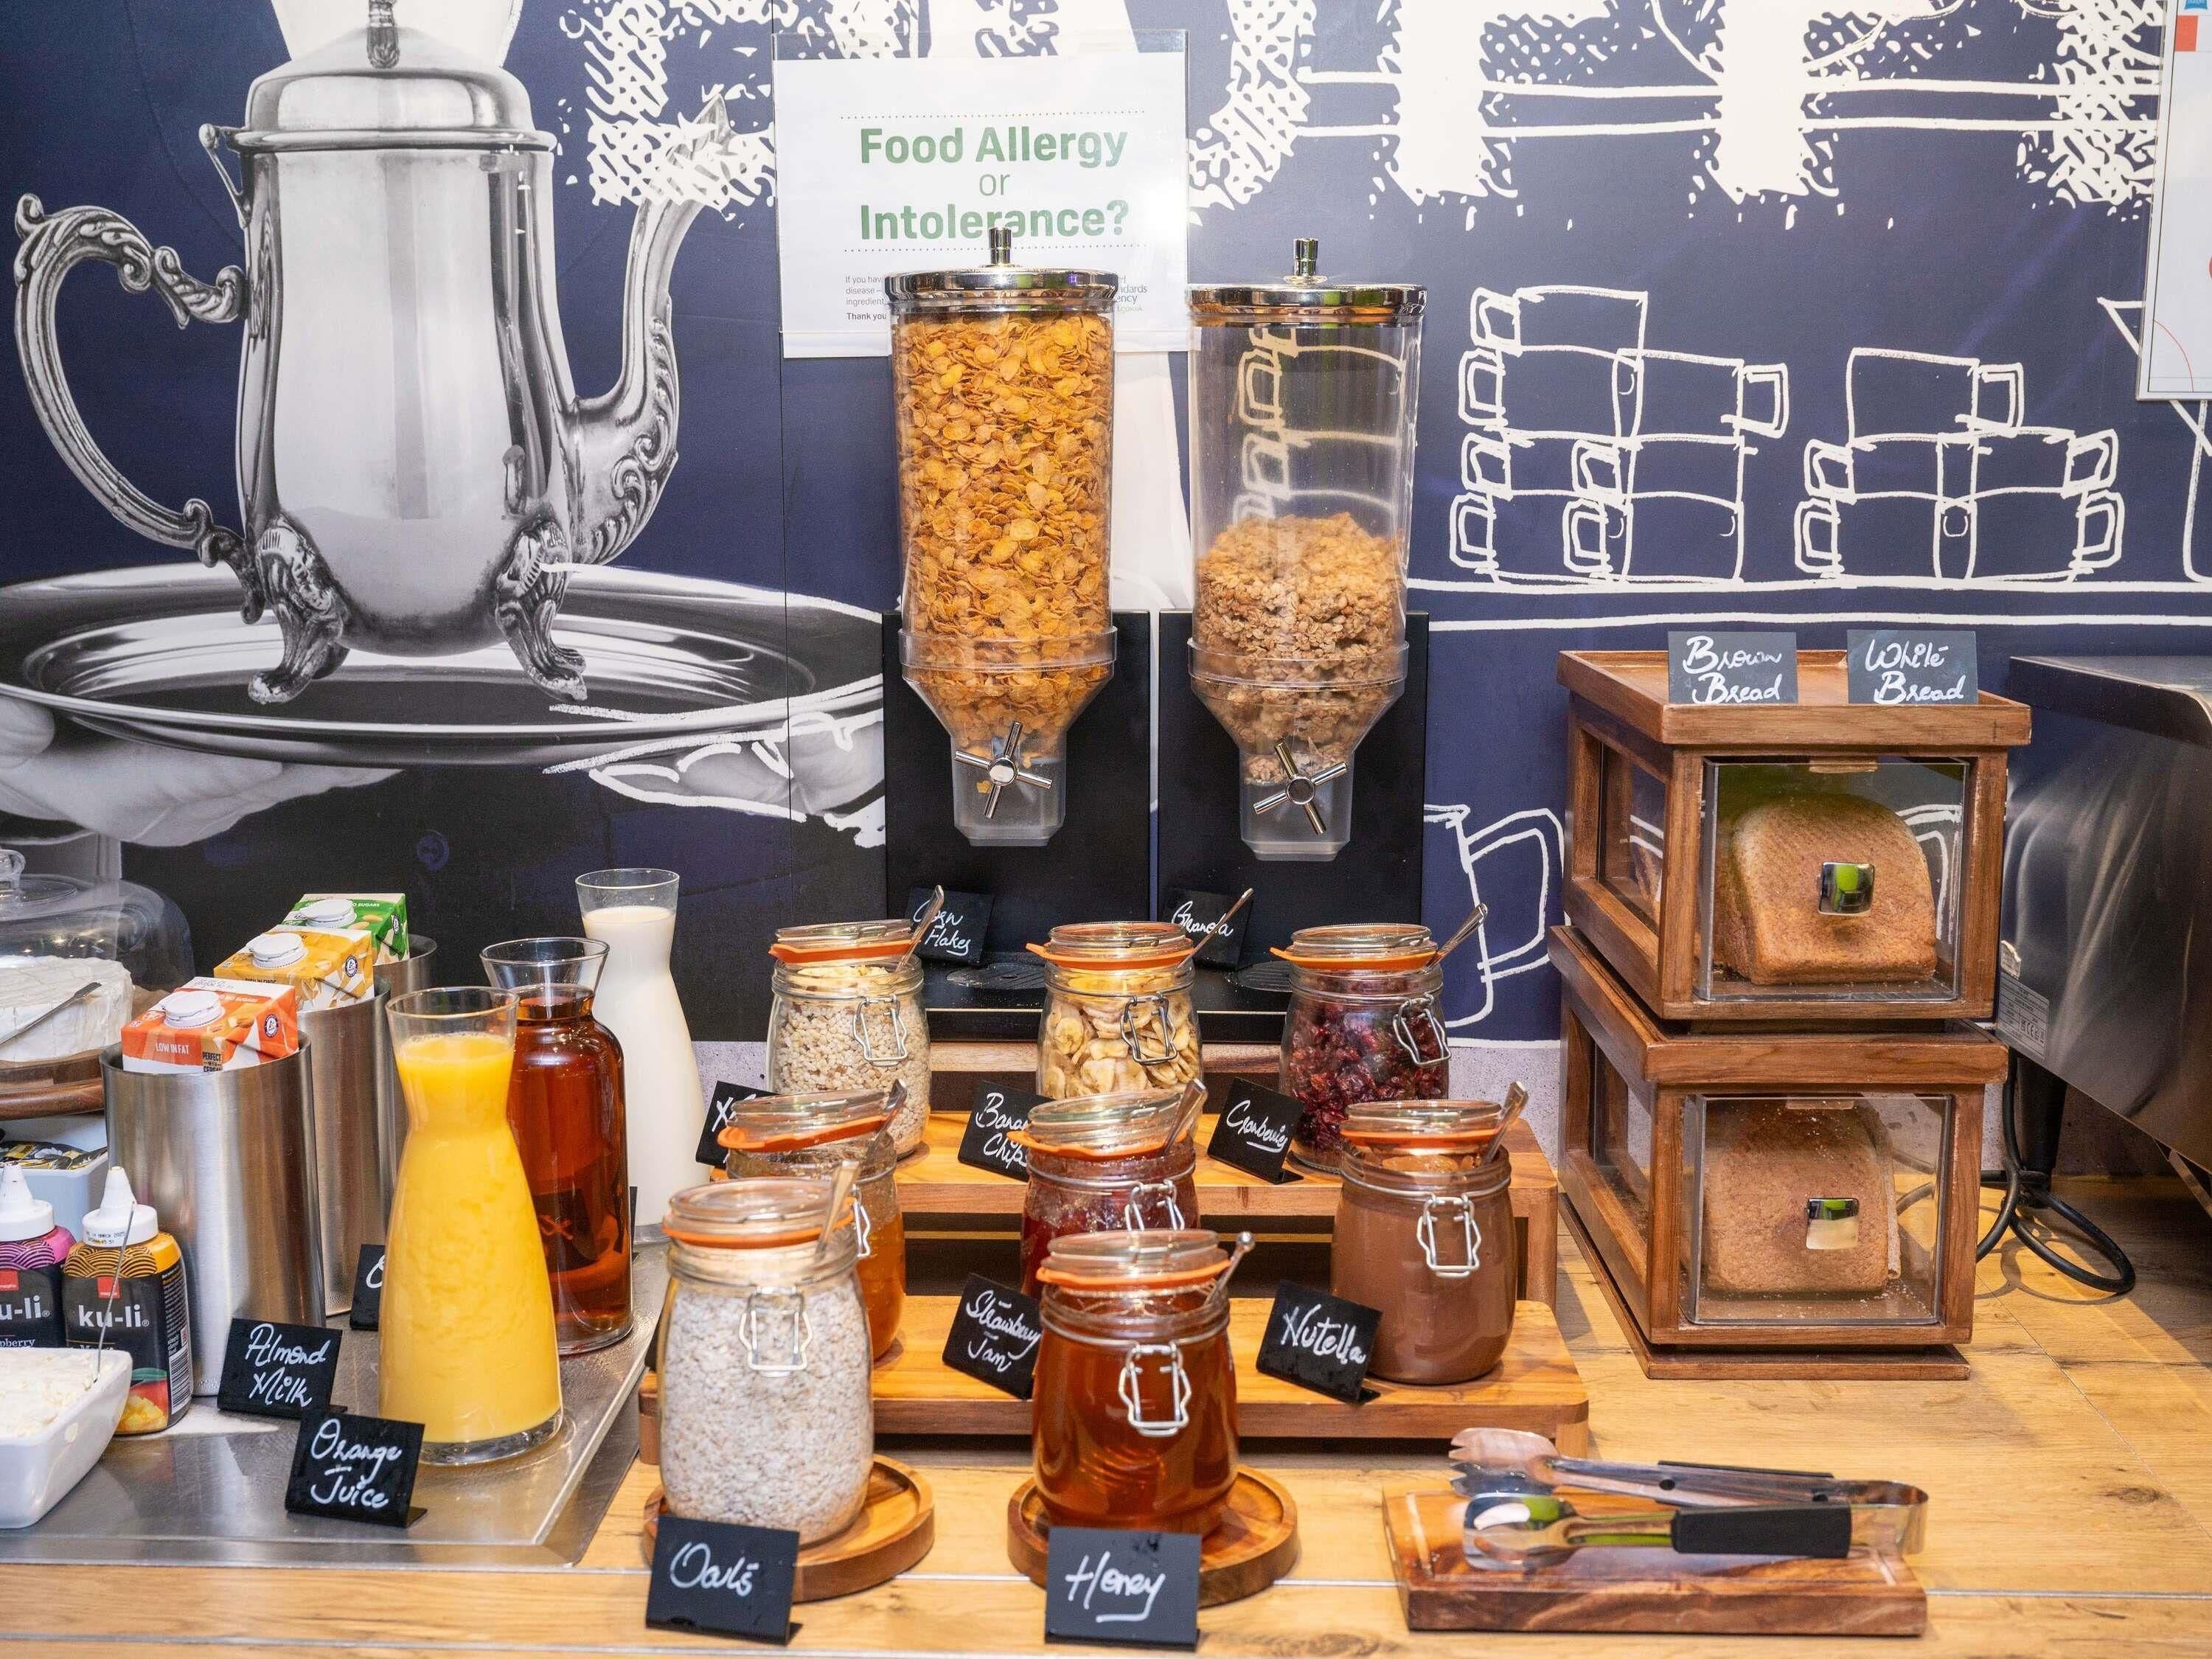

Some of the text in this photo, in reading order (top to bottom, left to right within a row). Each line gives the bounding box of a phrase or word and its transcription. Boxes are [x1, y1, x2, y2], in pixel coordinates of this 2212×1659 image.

[860, 126, 1128, 168] Food Allergy
[979, 174, 1010, 196] or
[860, 199, 1130, 240] Intolerance?
[845, 276, 850, 284] If
[852, 276, 866, 285] you
[846, 287, 874, 295] disease
[846, 297, 886, 307] ingredient
[1117, 295, 1138, 305] ency
[1682, 635, 1783, 674] Brown
[1864, 638, 1949, 672] White
[1691, 672, 1783, 704] Bread
[1873, 670, 1966, 704] Bread
[925, 925, 971, 956] Flakes
[155, 1042, 189, 1055] LOW IN FAT
[0, 1295, 41, 1321] u-li
[0, 1338, 36, 1348] pberry
[245, 1323, 331, 1367] Almond
[1280, 1303, 1367, 1365] Nutella
[248, 1366, 313, 1408] Milk
[310, 1418, 403, 1486] Orange
[310, 1466, 389, 1509] Juice
[669, 1541, 759, 1598] Oats
[1065, 1551, 1166, 1624] Honey
